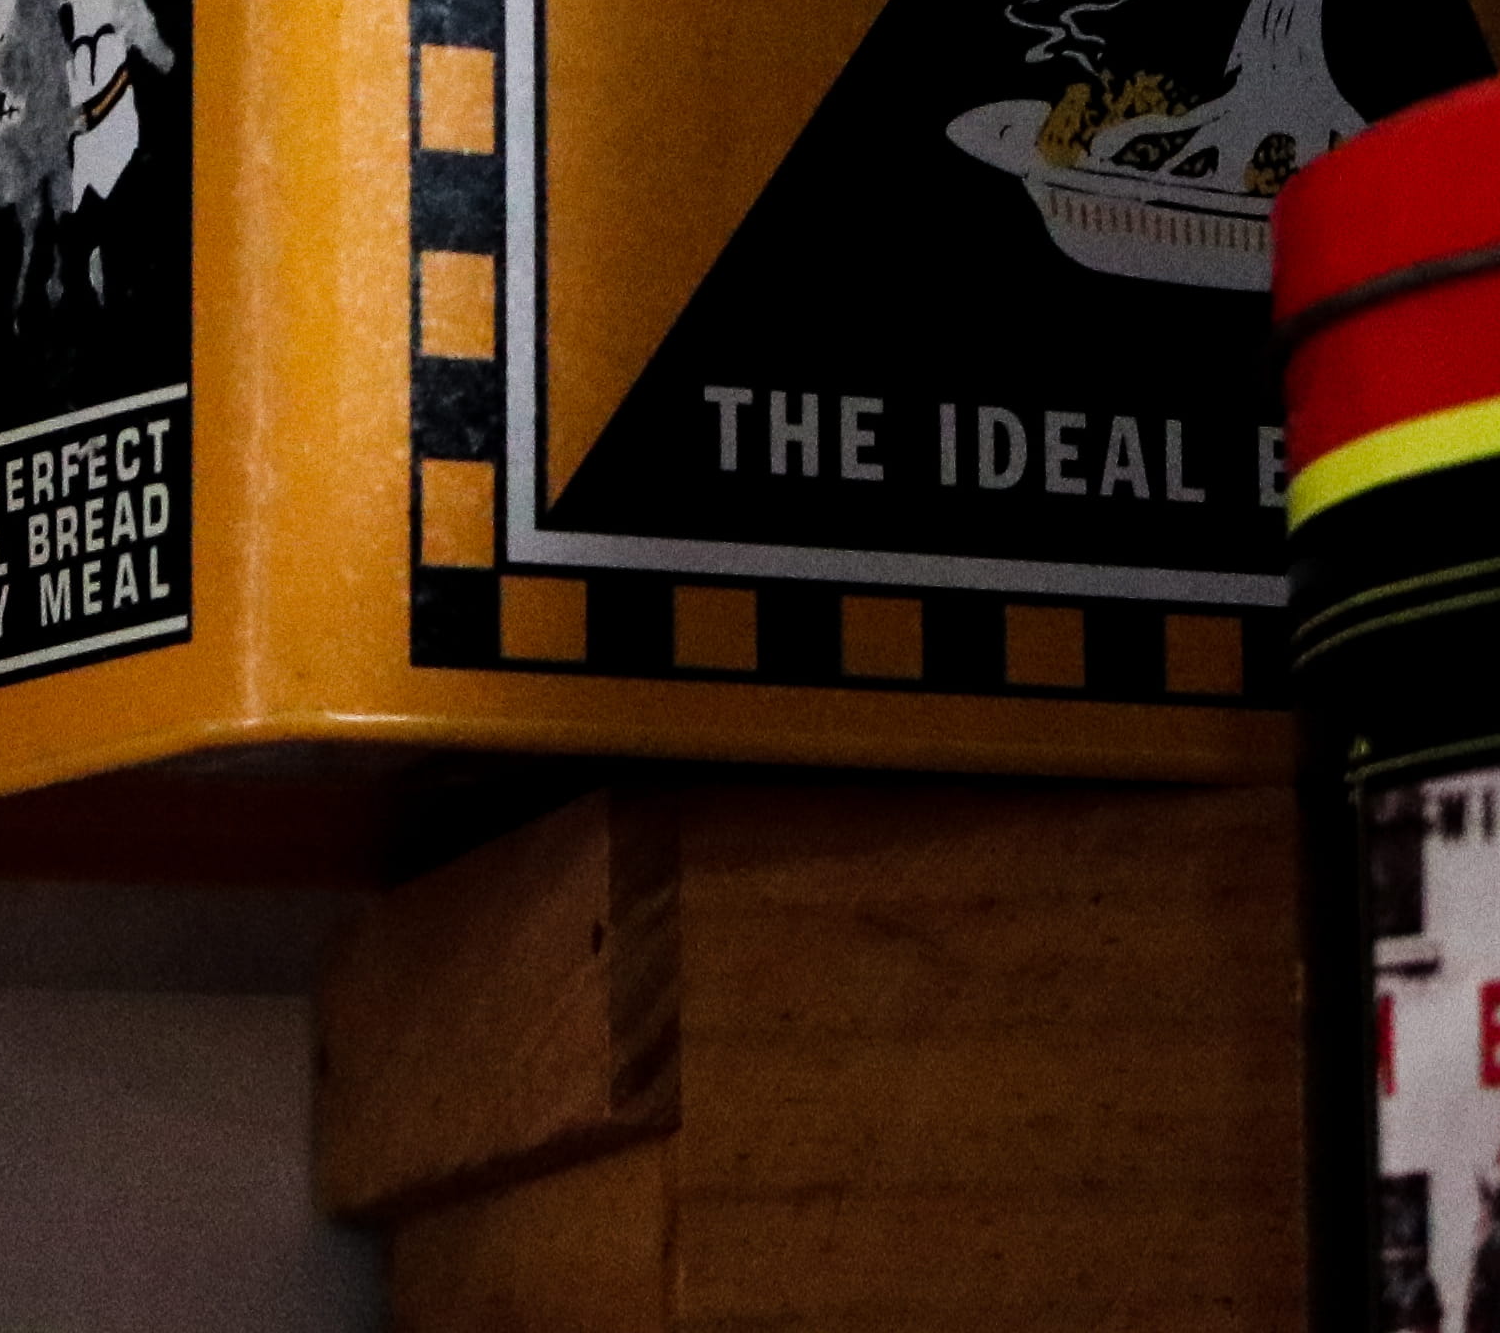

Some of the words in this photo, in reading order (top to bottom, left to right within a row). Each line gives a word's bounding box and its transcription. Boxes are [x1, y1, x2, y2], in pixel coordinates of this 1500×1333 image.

[703, 383, 885, 482] THE
[937, 401, 1207, 503] IDEAL
[27, 482, 170, 570] BREAD
[38, 545, 171, 628] MEAL
